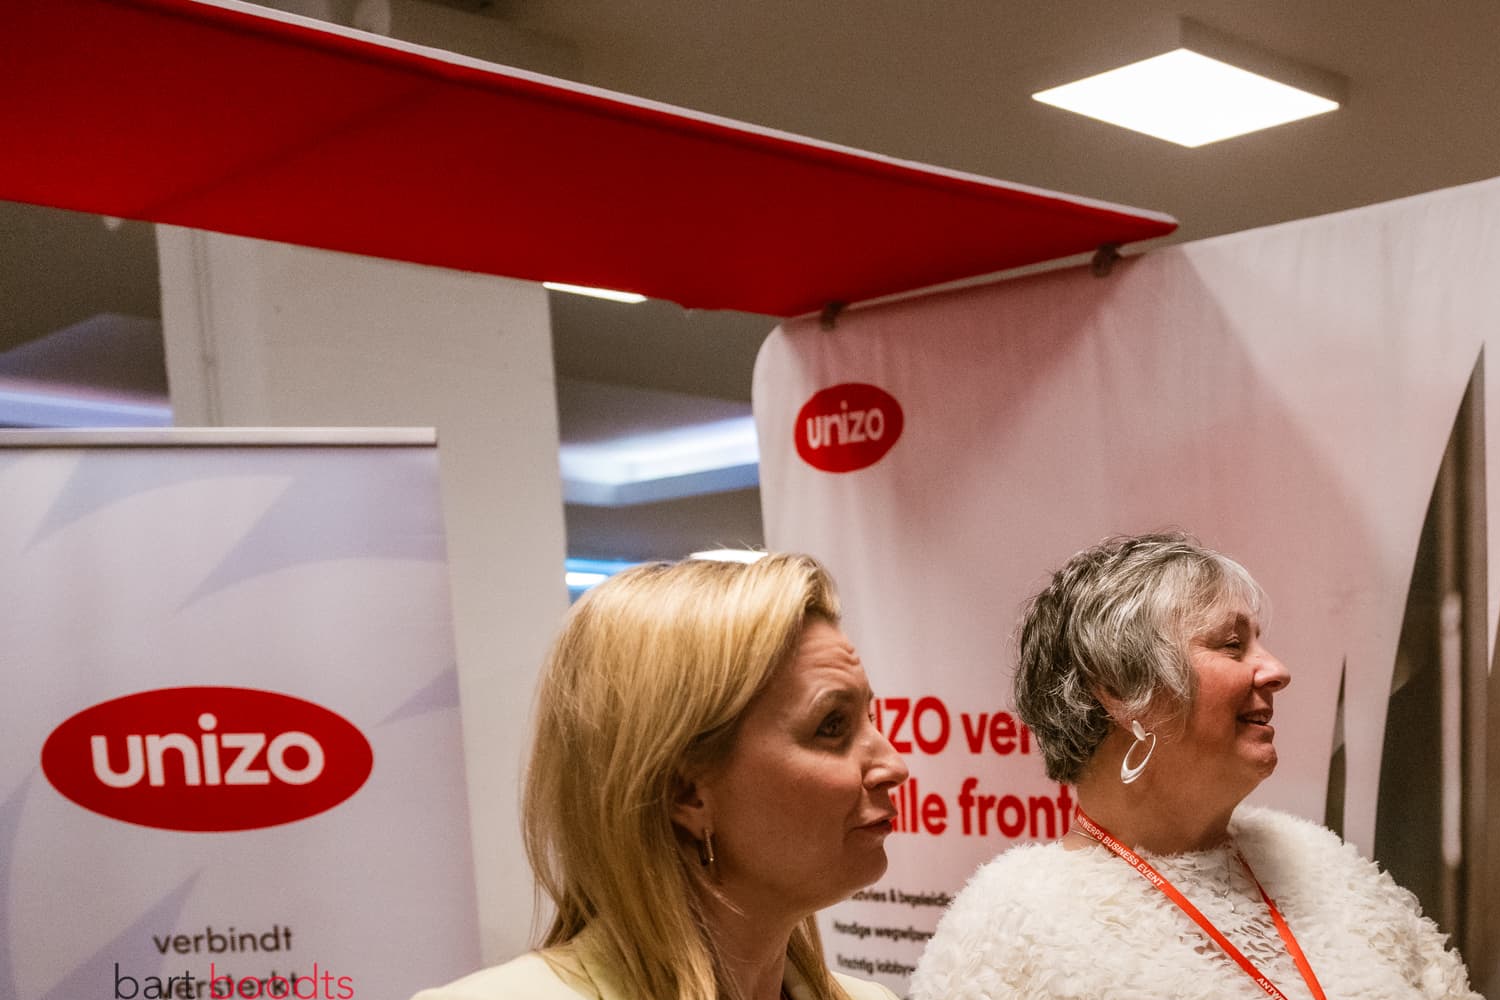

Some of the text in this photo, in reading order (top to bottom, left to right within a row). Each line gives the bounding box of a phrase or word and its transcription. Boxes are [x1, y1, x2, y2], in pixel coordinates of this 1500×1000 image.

[806, 400, 885, 449] unizo
[91, 713, 325, 788] unizo
[875, 696, 950, 755] IZO
[890, 777, 947, 835] lle
[1103, 836, 1139, 866] BUSINESS
[1137, 863, 1165, 887] EVENT
[153, 925, 293, 955] verbindt
